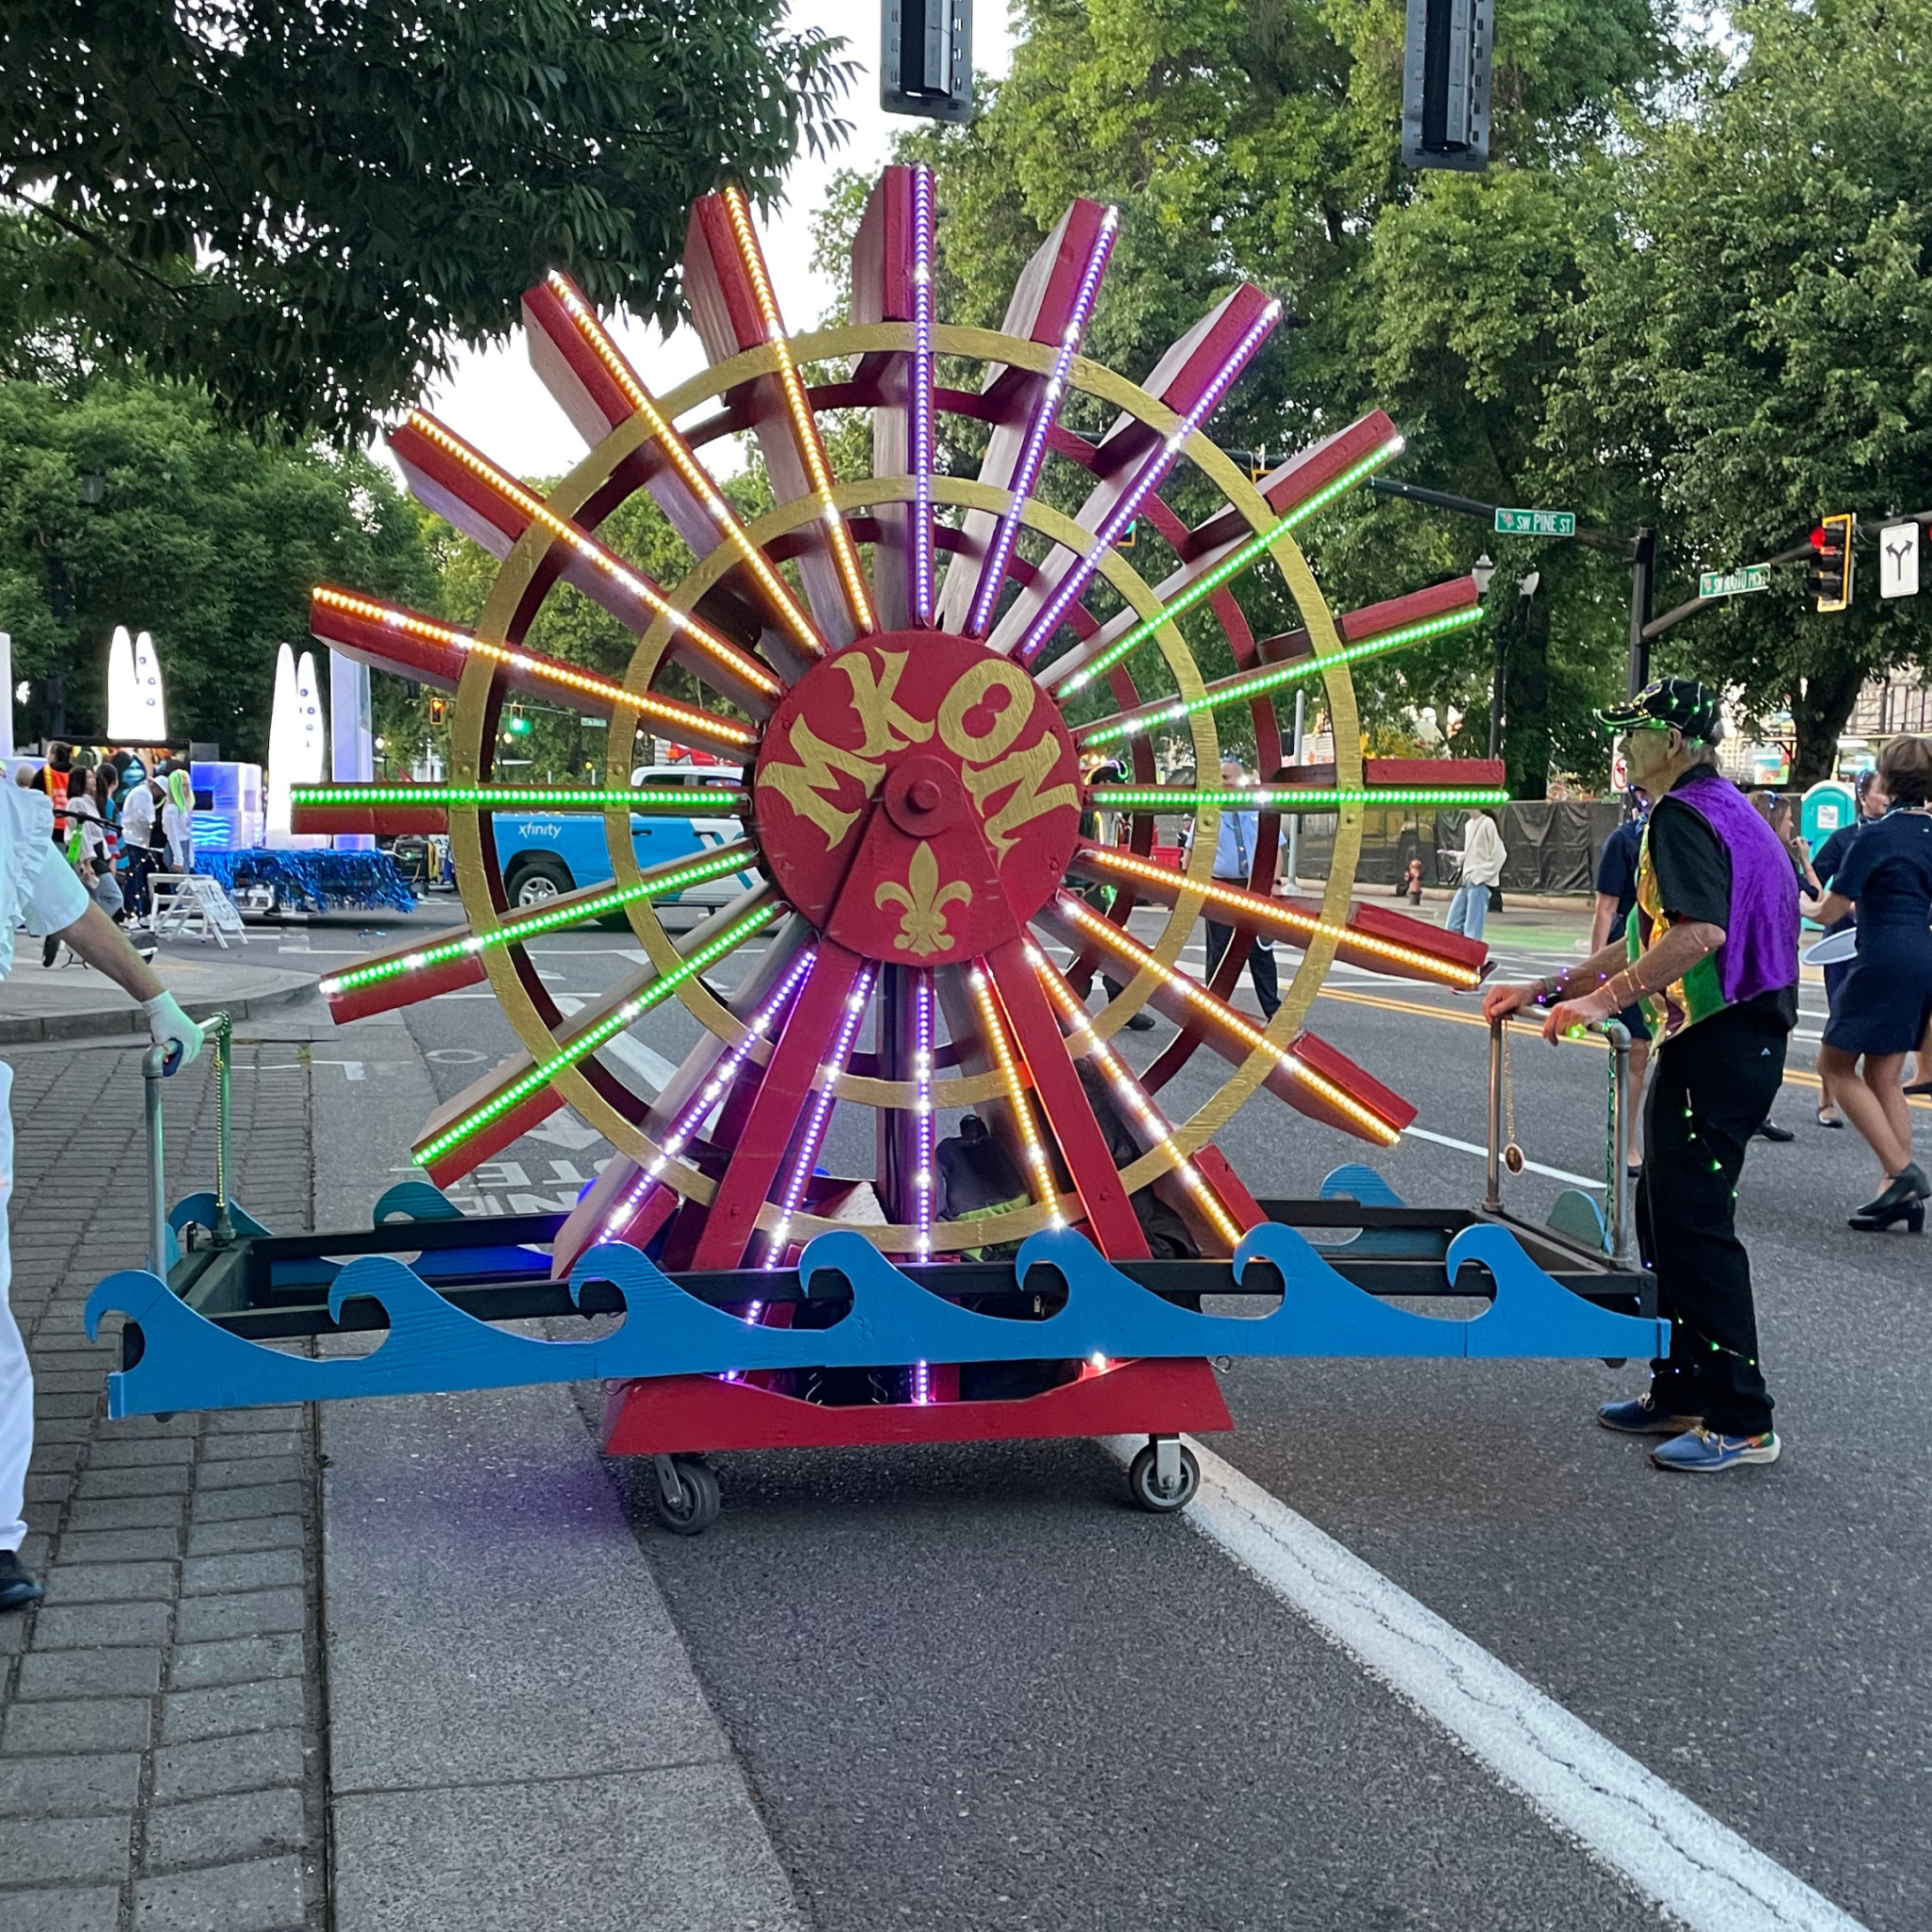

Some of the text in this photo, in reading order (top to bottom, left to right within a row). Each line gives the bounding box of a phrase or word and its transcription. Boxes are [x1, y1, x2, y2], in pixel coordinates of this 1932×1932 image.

[1517, 513, 1571, 533] SW PINE ST
[519, 821, 562, 839] xfinity
